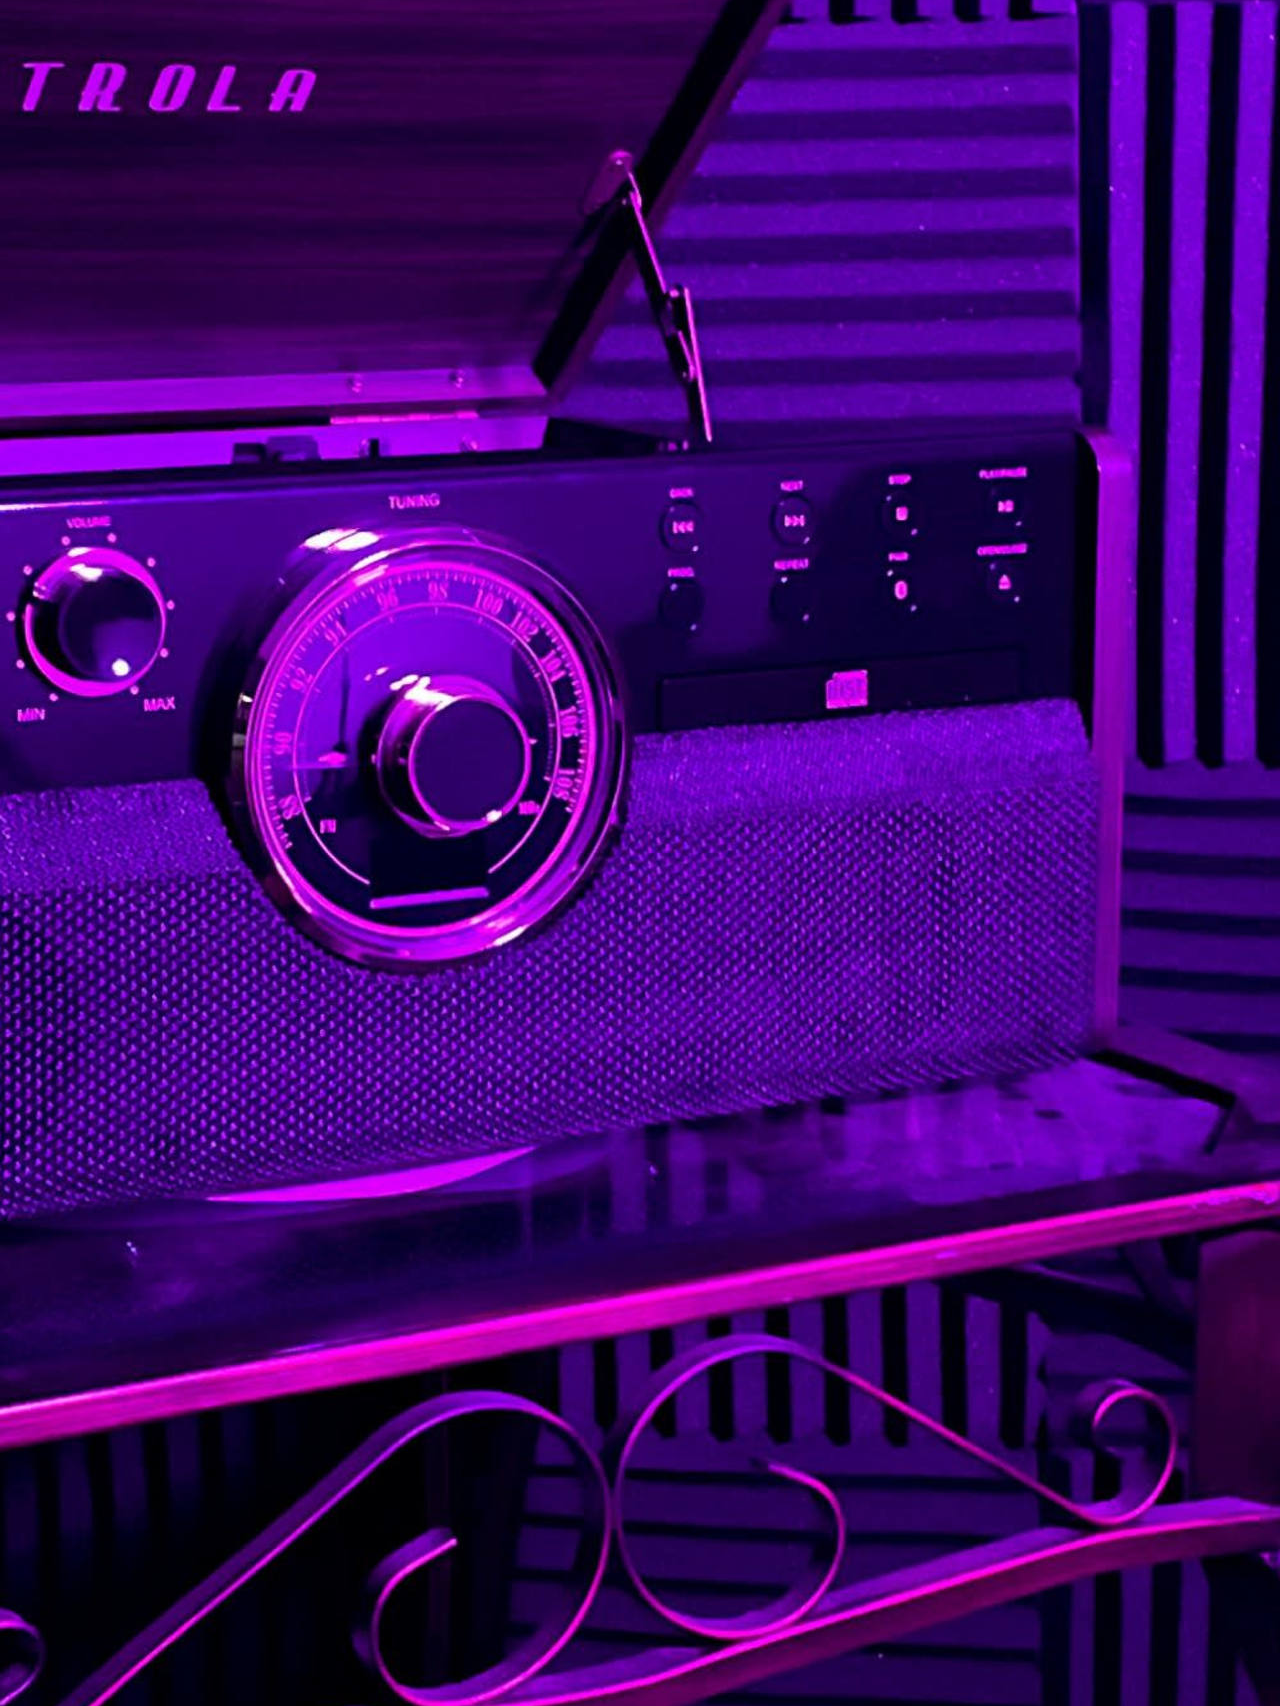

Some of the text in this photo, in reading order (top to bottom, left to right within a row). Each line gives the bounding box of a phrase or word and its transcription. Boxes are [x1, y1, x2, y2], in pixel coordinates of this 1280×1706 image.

[387, 492, 441, 510] TUNING
[66, 515, 112, 529] VOLUME
[475, 588, 504, 616] 100
[510, 610, 540, 644] 102
[288, 665, 315, 692] 92
[143, 696, 176, 712] MAX
[17, 707, 46, 723] MIN
